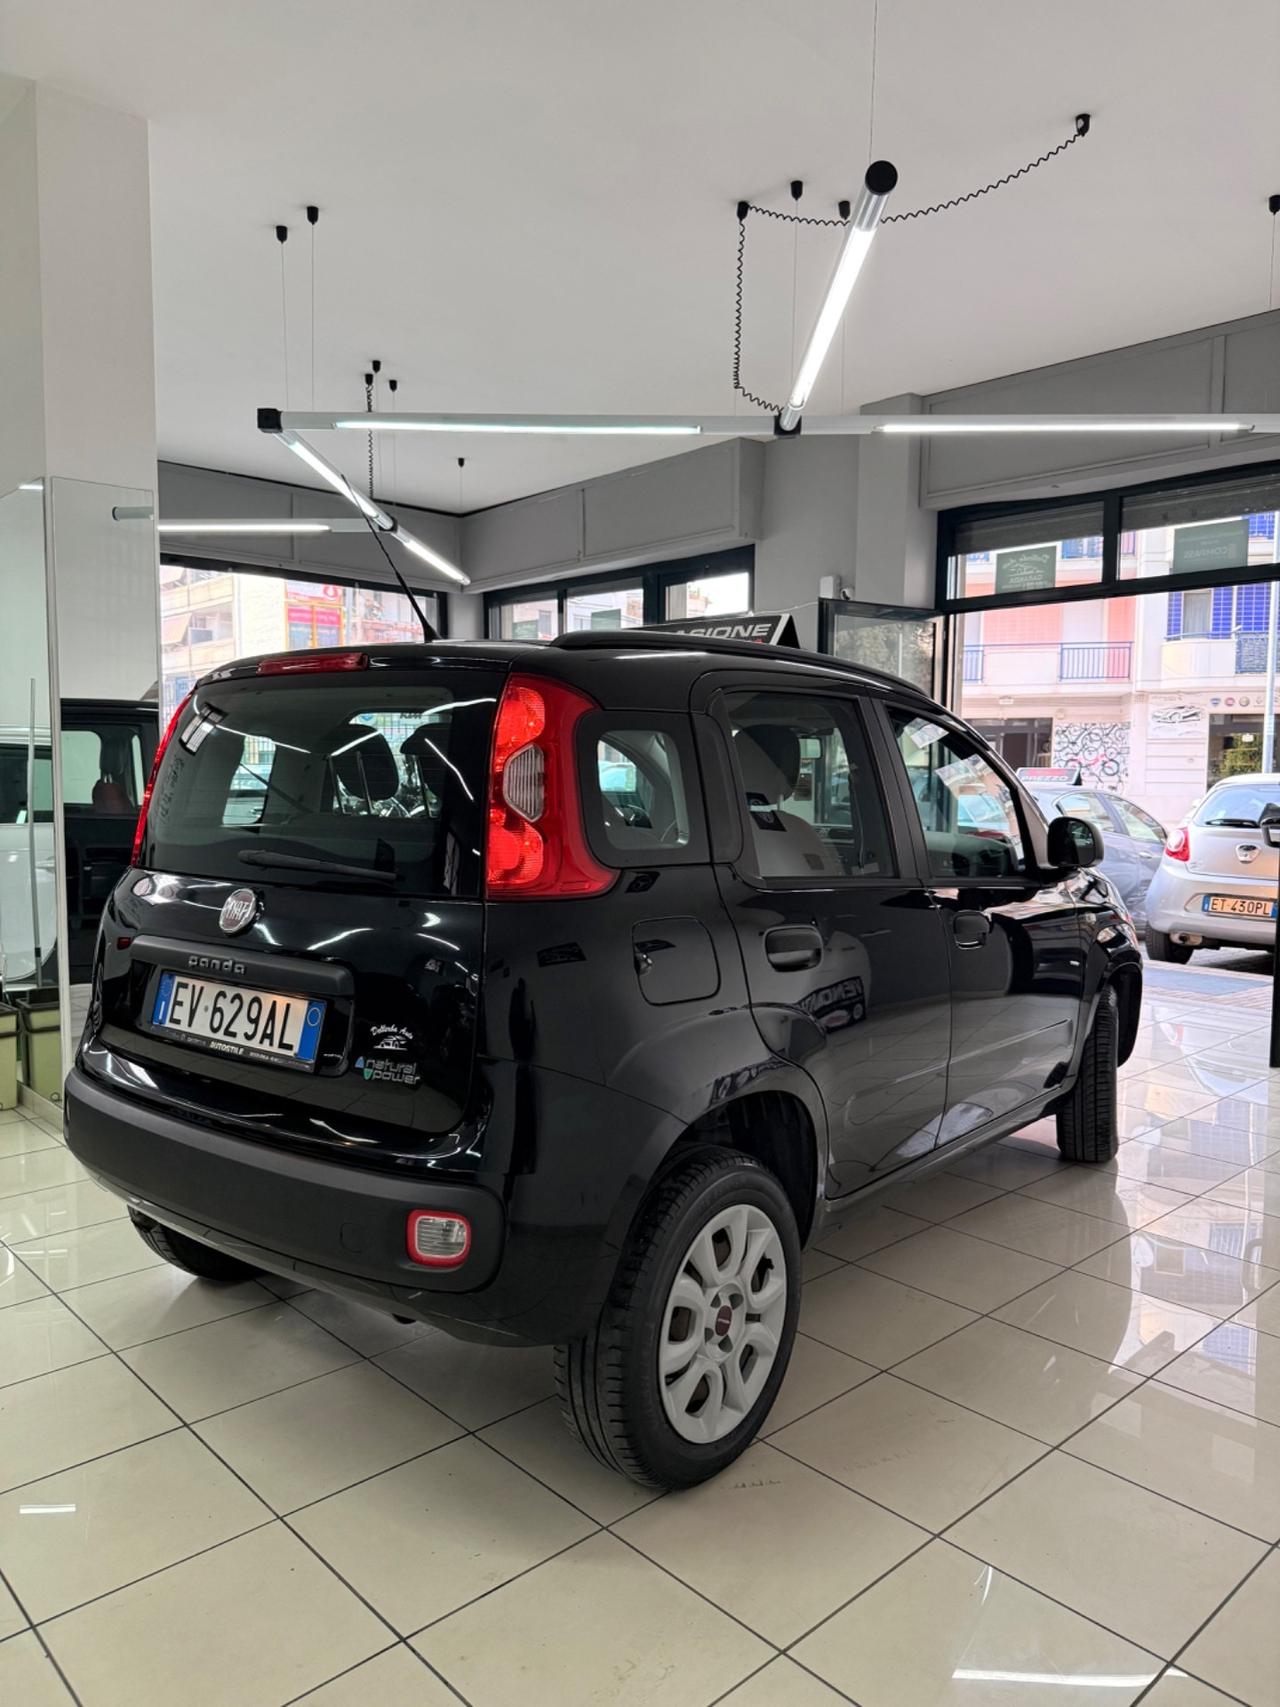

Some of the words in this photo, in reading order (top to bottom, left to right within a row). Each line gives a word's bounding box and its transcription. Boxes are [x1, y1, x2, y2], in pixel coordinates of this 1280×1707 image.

[676, 623, 773, 639] SIONE
[226, 895, 250, 920] FIAT
[1211, 898, 1226, 911] ET
[1230, 900, 1270, 915] 430PL
[188, 955, 245, 976] panda
[209, 990, 294, 1051] 629AL
[366, 1058, 417, 1075] natural
[372, 1069, 420, 1085] power
